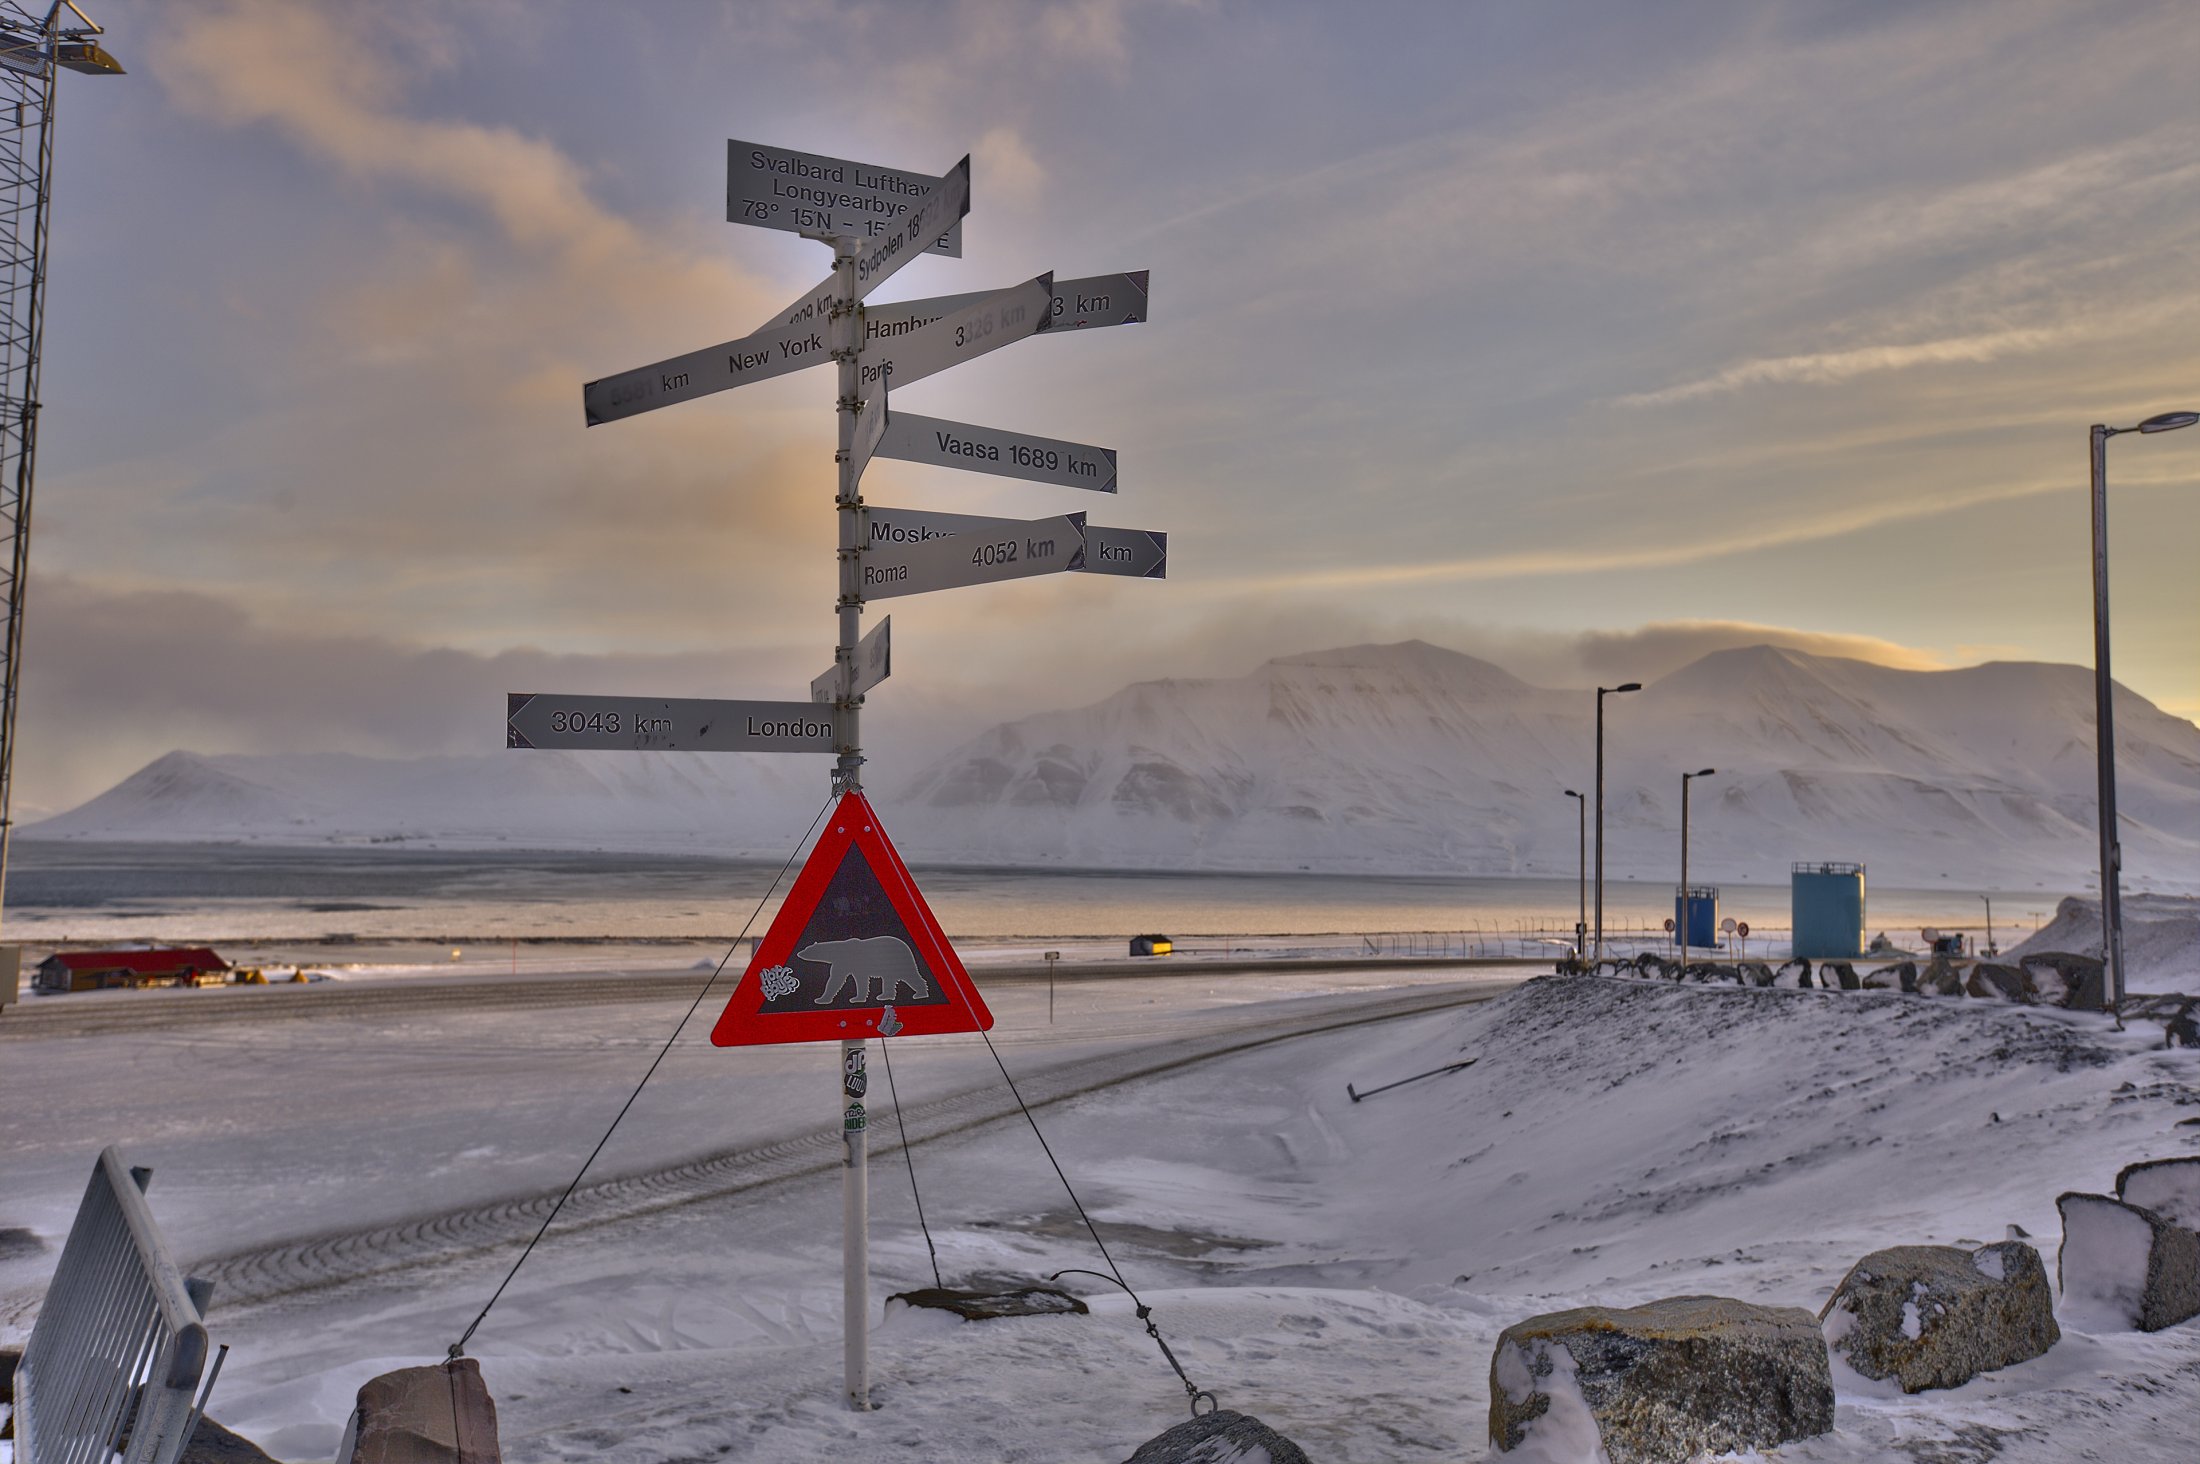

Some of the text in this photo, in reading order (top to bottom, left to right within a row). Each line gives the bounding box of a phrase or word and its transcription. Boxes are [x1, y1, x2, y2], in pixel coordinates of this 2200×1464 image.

[750, 151, 930, 197] Svalbard Lufthav
[742, 199, 779, 220] 78°
[774, 178, 909, 217] Longyearbye
[859, 232, 904, 281] Sydpolen
[816, 294, 833, 317] km
[1076, 294, 1110, 313] km
[663, 371, 689, 392] km
[729, 349, 770, 374] New
[778, 333, 823, 358] York
[935, 431, 1097, 477] Vaasa 1689 km
[864, 538, 1055, 585] Roma 4052 km
[871, 521, 1132, 562] Mosk km
[551, 711, 833, 739] 3043 km London
